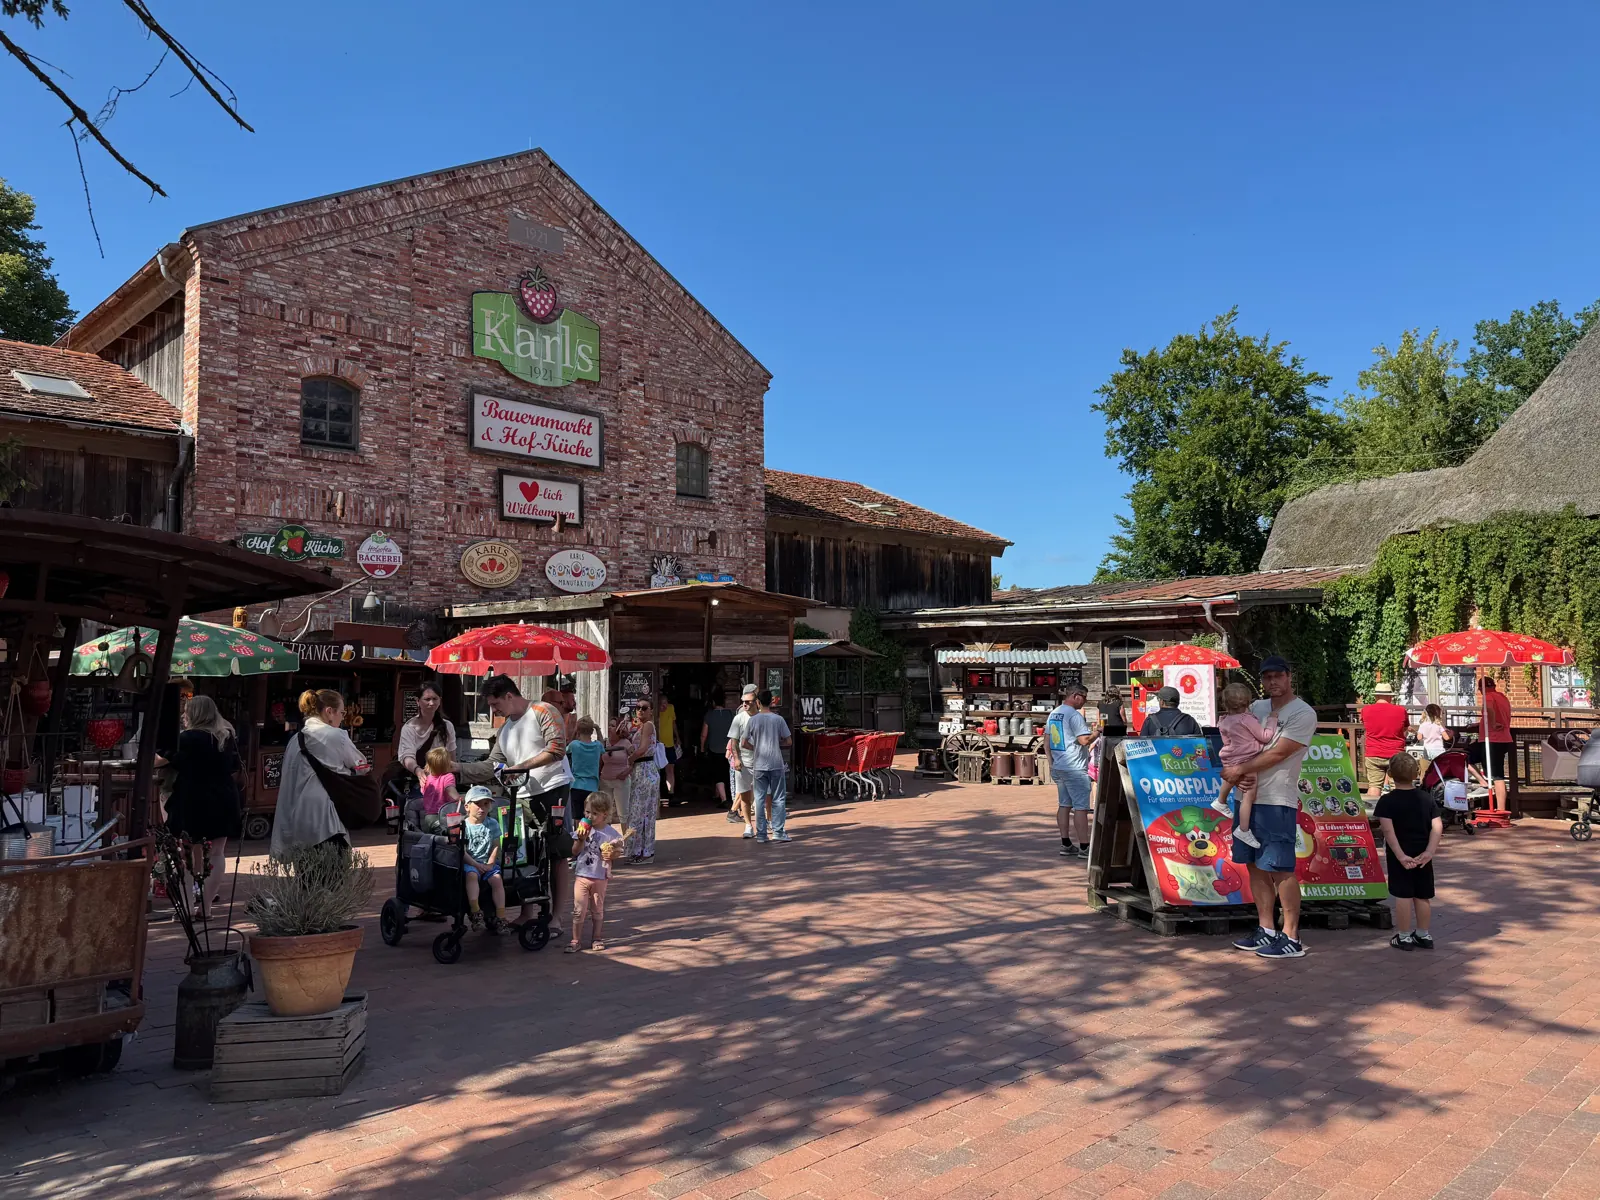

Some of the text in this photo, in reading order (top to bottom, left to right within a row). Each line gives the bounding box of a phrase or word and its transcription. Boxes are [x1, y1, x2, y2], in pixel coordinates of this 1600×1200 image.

[524, 226, 549, 245] 1921
[480, 308, 593, 372] Karls
[529, 365, 553, 382] 1921
[481, 399, 593, 436] Bauernmarkt
[481, 426, 594, 458] & Hof-Küche
[246, 535, 341, 554] Hof Küche
[475, 546, 509, 557] KARLS
[569, 552, 585, 561] KARLS
[279, 641, 340, 662] TRÄNKE
[800, 697, 823, 715] WC
[1126, 740, 1149, 751] EINFACH
[1163, 758, 1199, 770] Karls
[1152, 777, 1234, 795] DORFPLA
[1148, 795, 1157, 803] Für
[1148, 834, 1176, 845] SHOPPEN
[1300, 885, 1367, 897] KARLS.DE/JOBS
